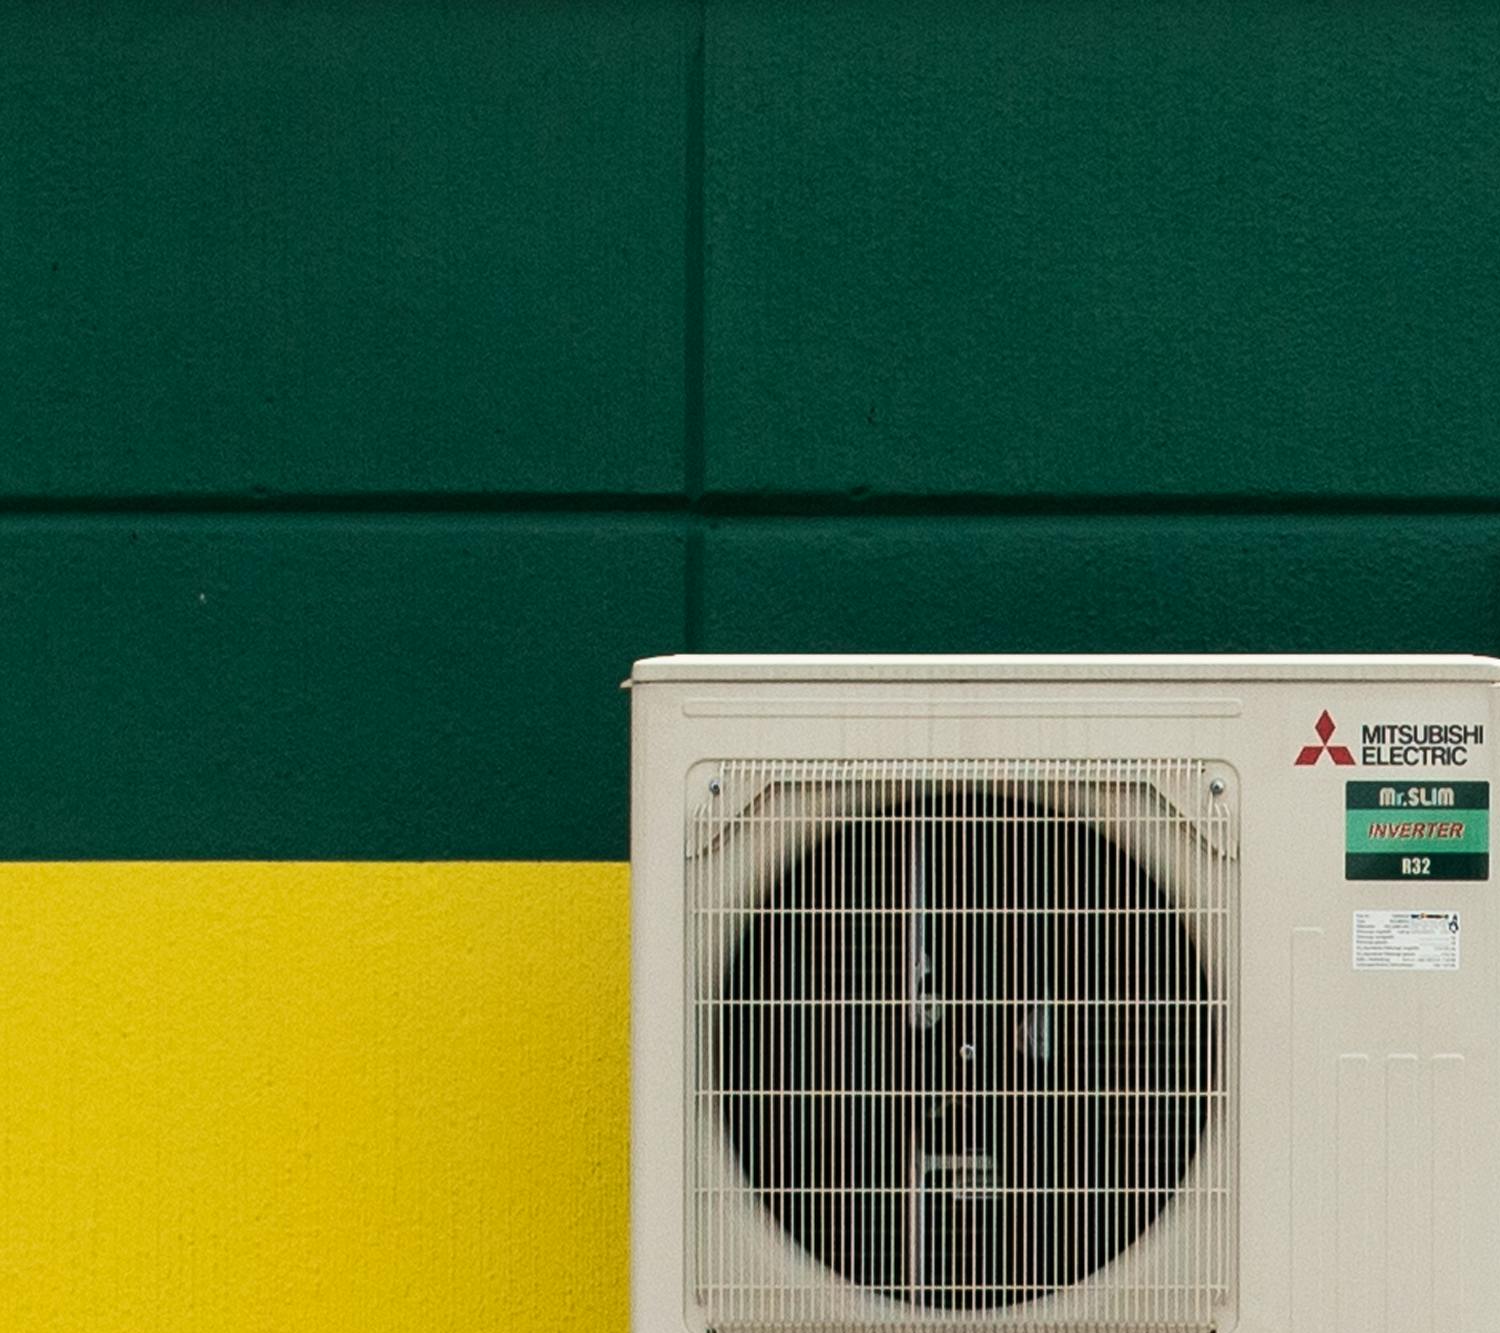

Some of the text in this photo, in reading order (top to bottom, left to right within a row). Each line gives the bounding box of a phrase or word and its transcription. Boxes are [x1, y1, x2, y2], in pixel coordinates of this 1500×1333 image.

[1361, 724, 1484, 744] MITSUBISHI
[1361, 746, 1468, 766] ELECTRIC
[1379, 787, 1455, 807] Mr.SLIM
[1368, 822, 1466, 840] INVERTER
[1402, 857, 1431, 875] R32
